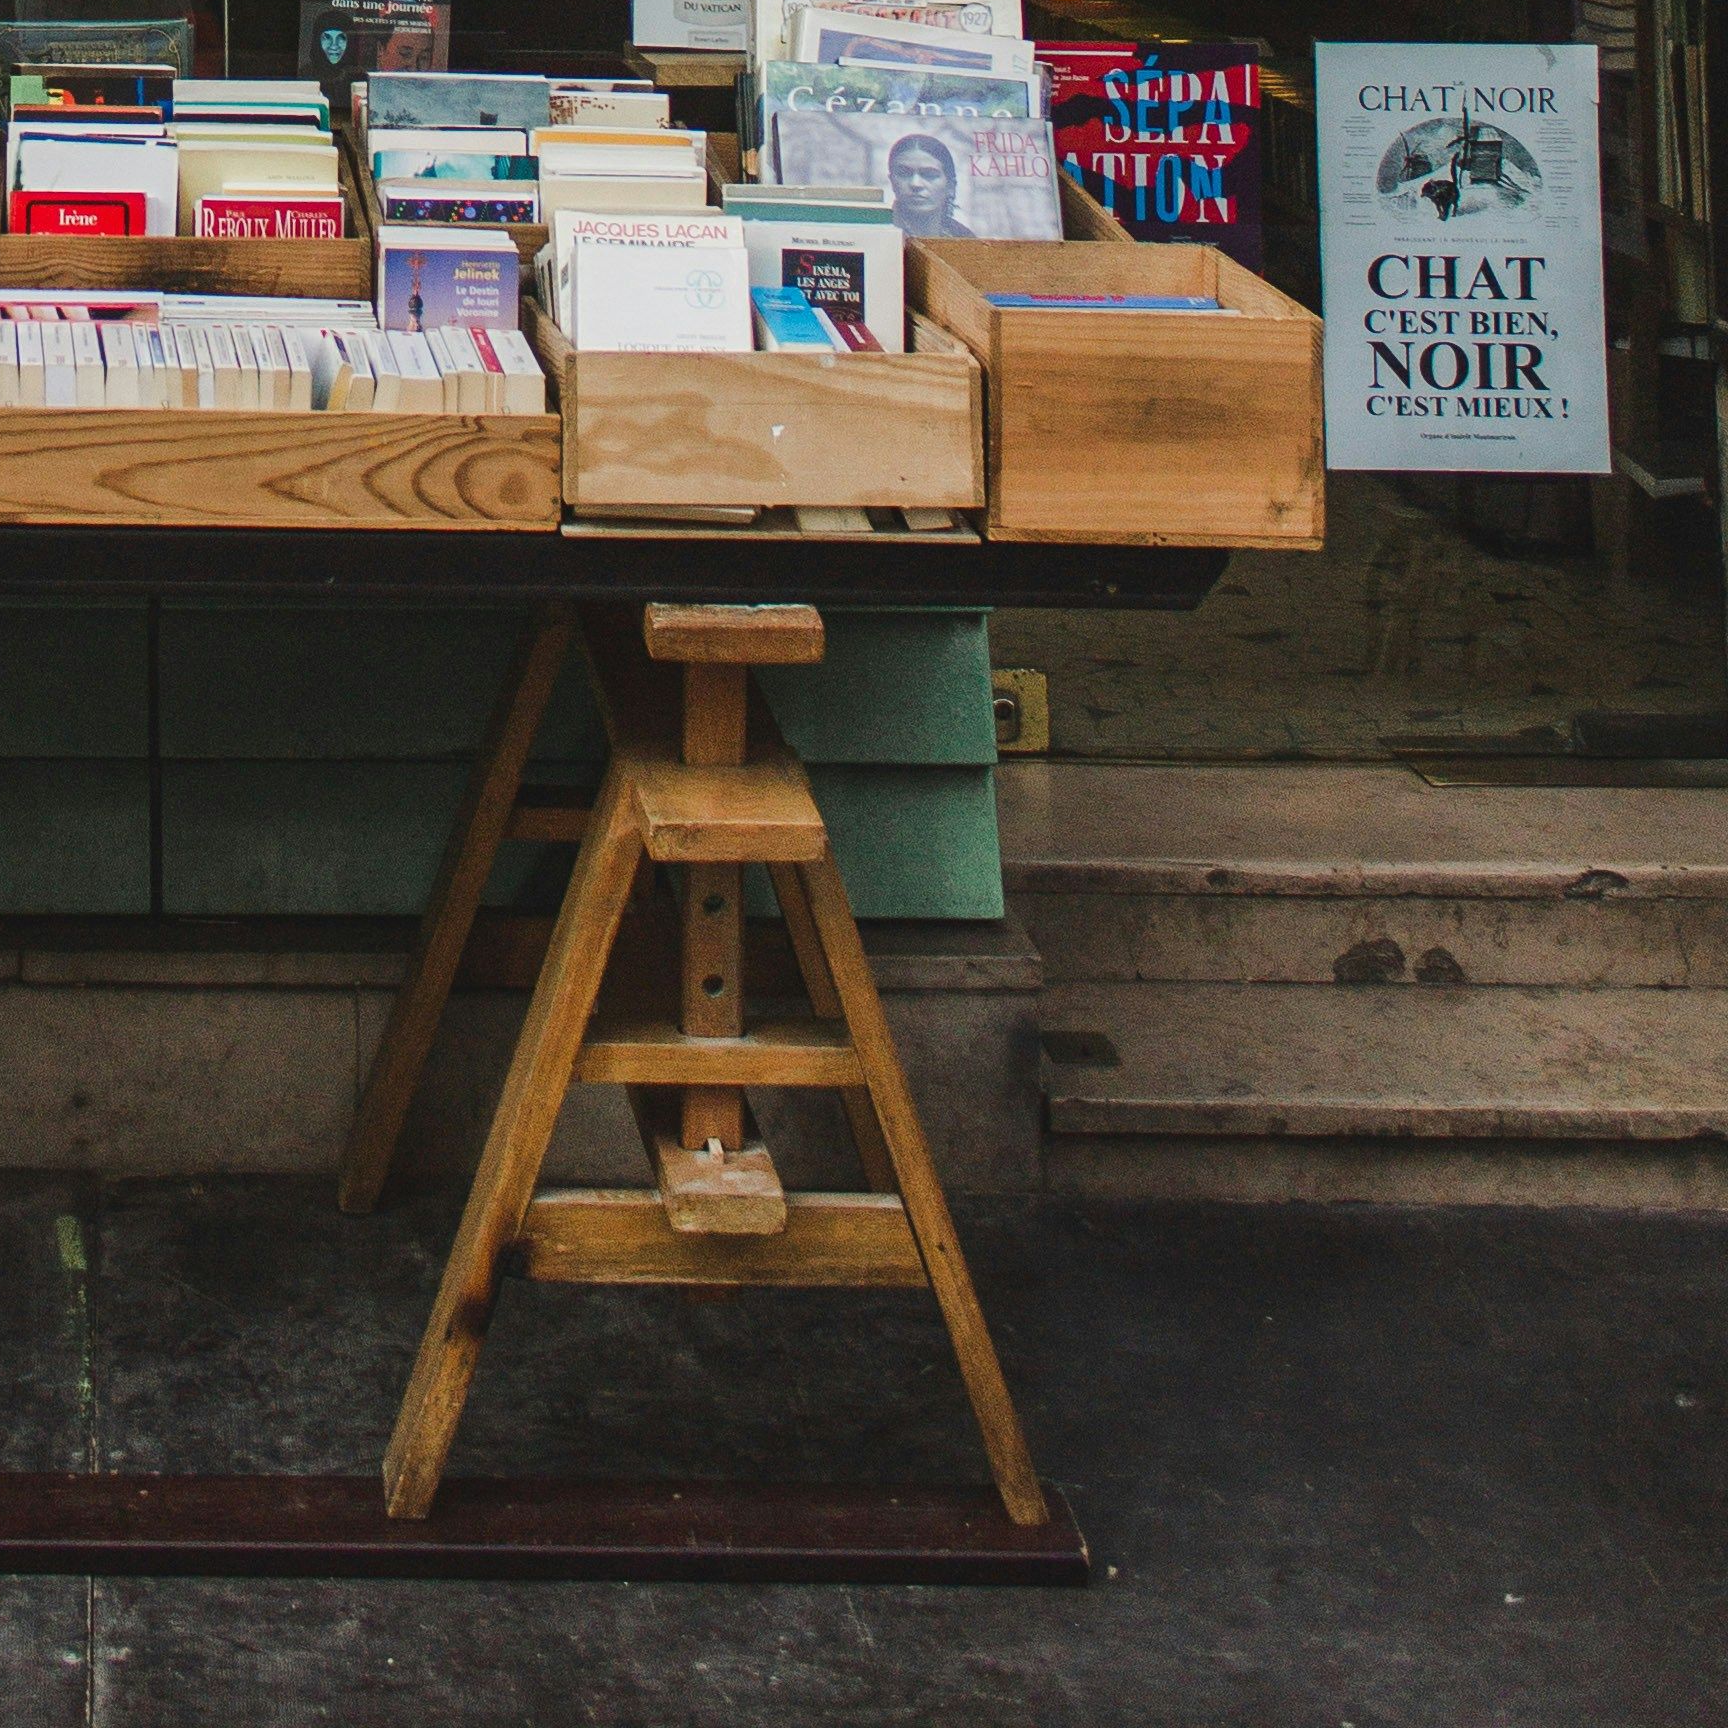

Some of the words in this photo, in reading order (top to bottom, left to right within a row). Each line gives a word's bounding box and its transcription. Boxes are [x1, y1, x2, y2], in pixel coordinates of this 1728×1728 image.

[362, 0, 385, 10] une
[386, 0, 433, 14] journée
[684, 2, 699, 12] DU
[701, 1, 742, 13] VATICAN
[962, 11, 989, 26] 1927
[1103, 54, 1236, 144] SÉPA
[1358, 84, 1454, 112] CHAT
[1473, 86, 1558, 113] NOIR
[971, 129, 1041, 155] FRIDA
[970, 155, 1051, 179] KAHLO
[59, 206, 98, 226] Irène
[226, 209, 245, 219] PAUL
[291, 210, 328, 219] CHARLES
[572, 220, 659, 239] JACQUES
[665, 224, 728, 241] LACAN
[453, 268, 501, 282] Jelinek
[798, 254, 851, 279] SINÉMA,
[797, 277, 815, 288] LES
[817, 278, 850, 290] ANGES
[1367, 253, 1546, 301] CHAT
[455, 285, 467, 295] Le
[469, 285, 500, 296] Destin
[815, 290, 841, 302] AVEC
[842, 291, 860, 303] TOI
[462, 296, 475, 307] de
[456, 307, 500, 318] Voronine
[1363, 309, 1460, 335] C'EST
[1468, 311, 1558, 341] BIEN,
[1366, 340, 1550, 391] NOIR
[1366, 395, 1448, 418] C'EST
[1456, 396, 1555, 420] MIEUX
[1561, 396, 1569, 419] !
